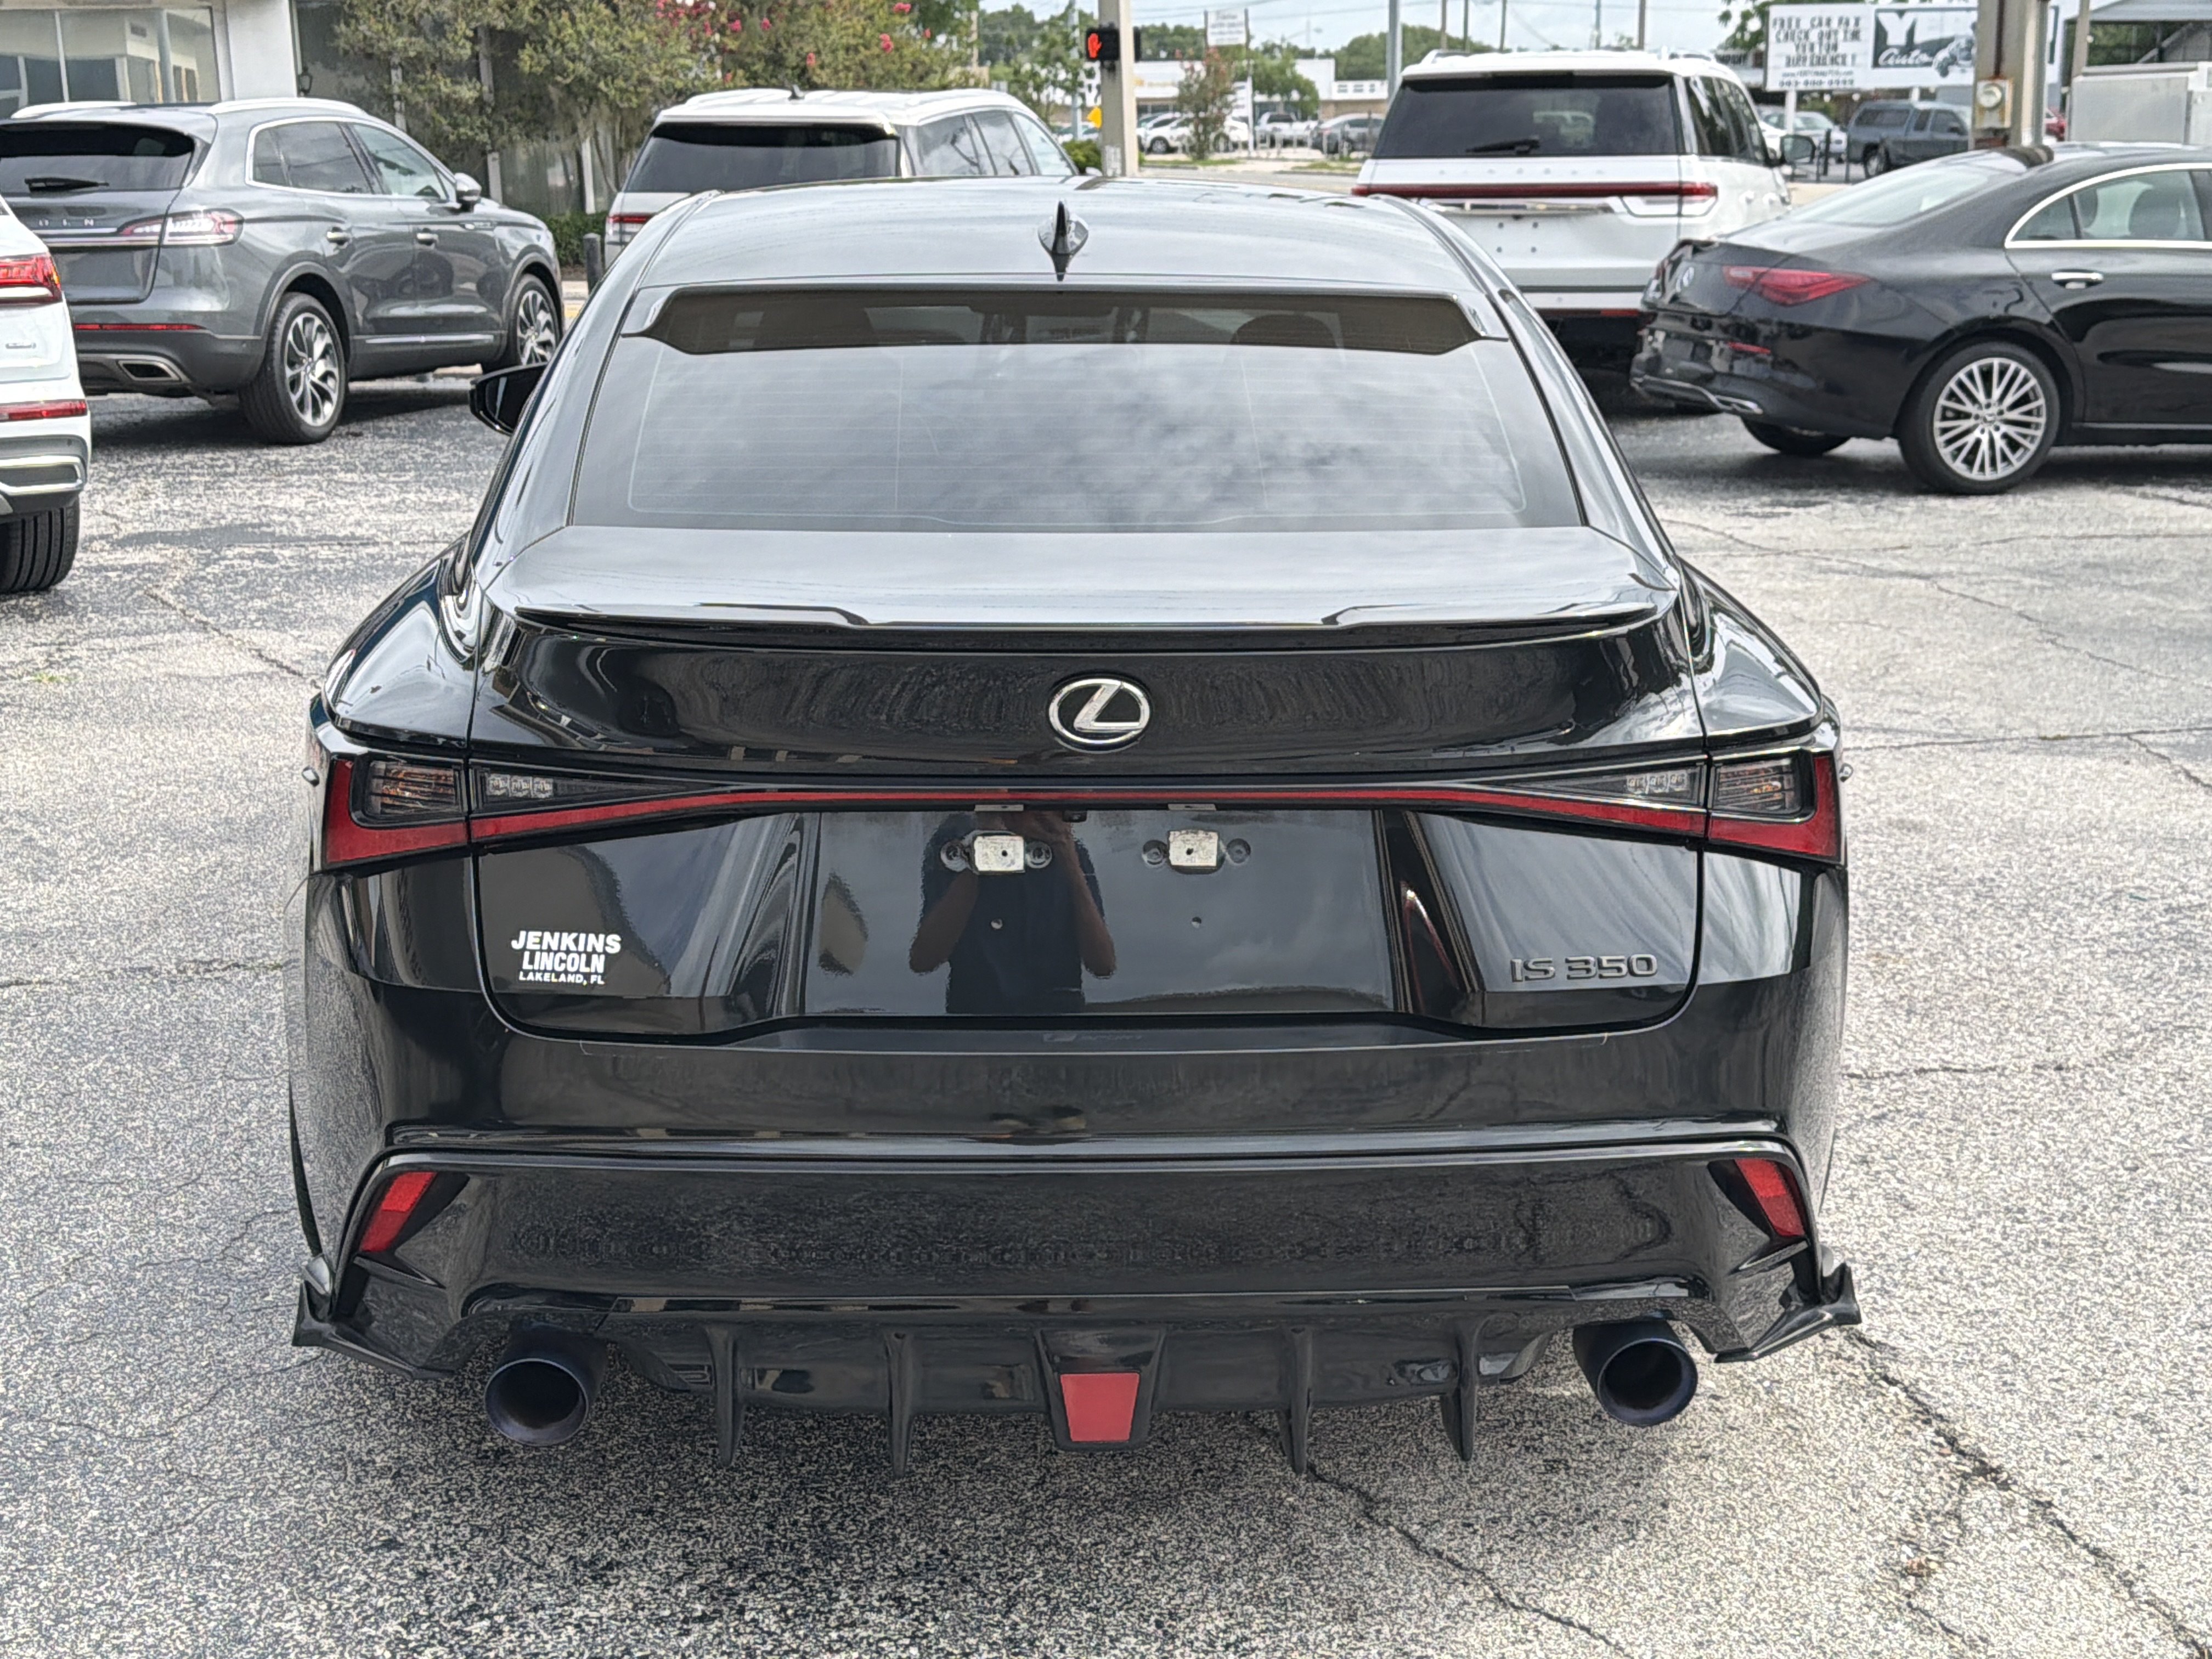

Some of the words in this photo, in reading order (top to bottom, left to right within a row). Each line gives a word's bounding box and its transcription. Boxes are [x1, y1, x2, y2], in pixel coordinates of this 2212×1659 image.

[511, 930, 622, 953] JENKINS
[522, 951, 605, 973] LINCOLN
[1510, 958, 1556, 982] IS
[1565, 954, 1657, 979] 350
[519, 971, 588, 985] LAKELAND,
[590, 974, 606, 985] FL
